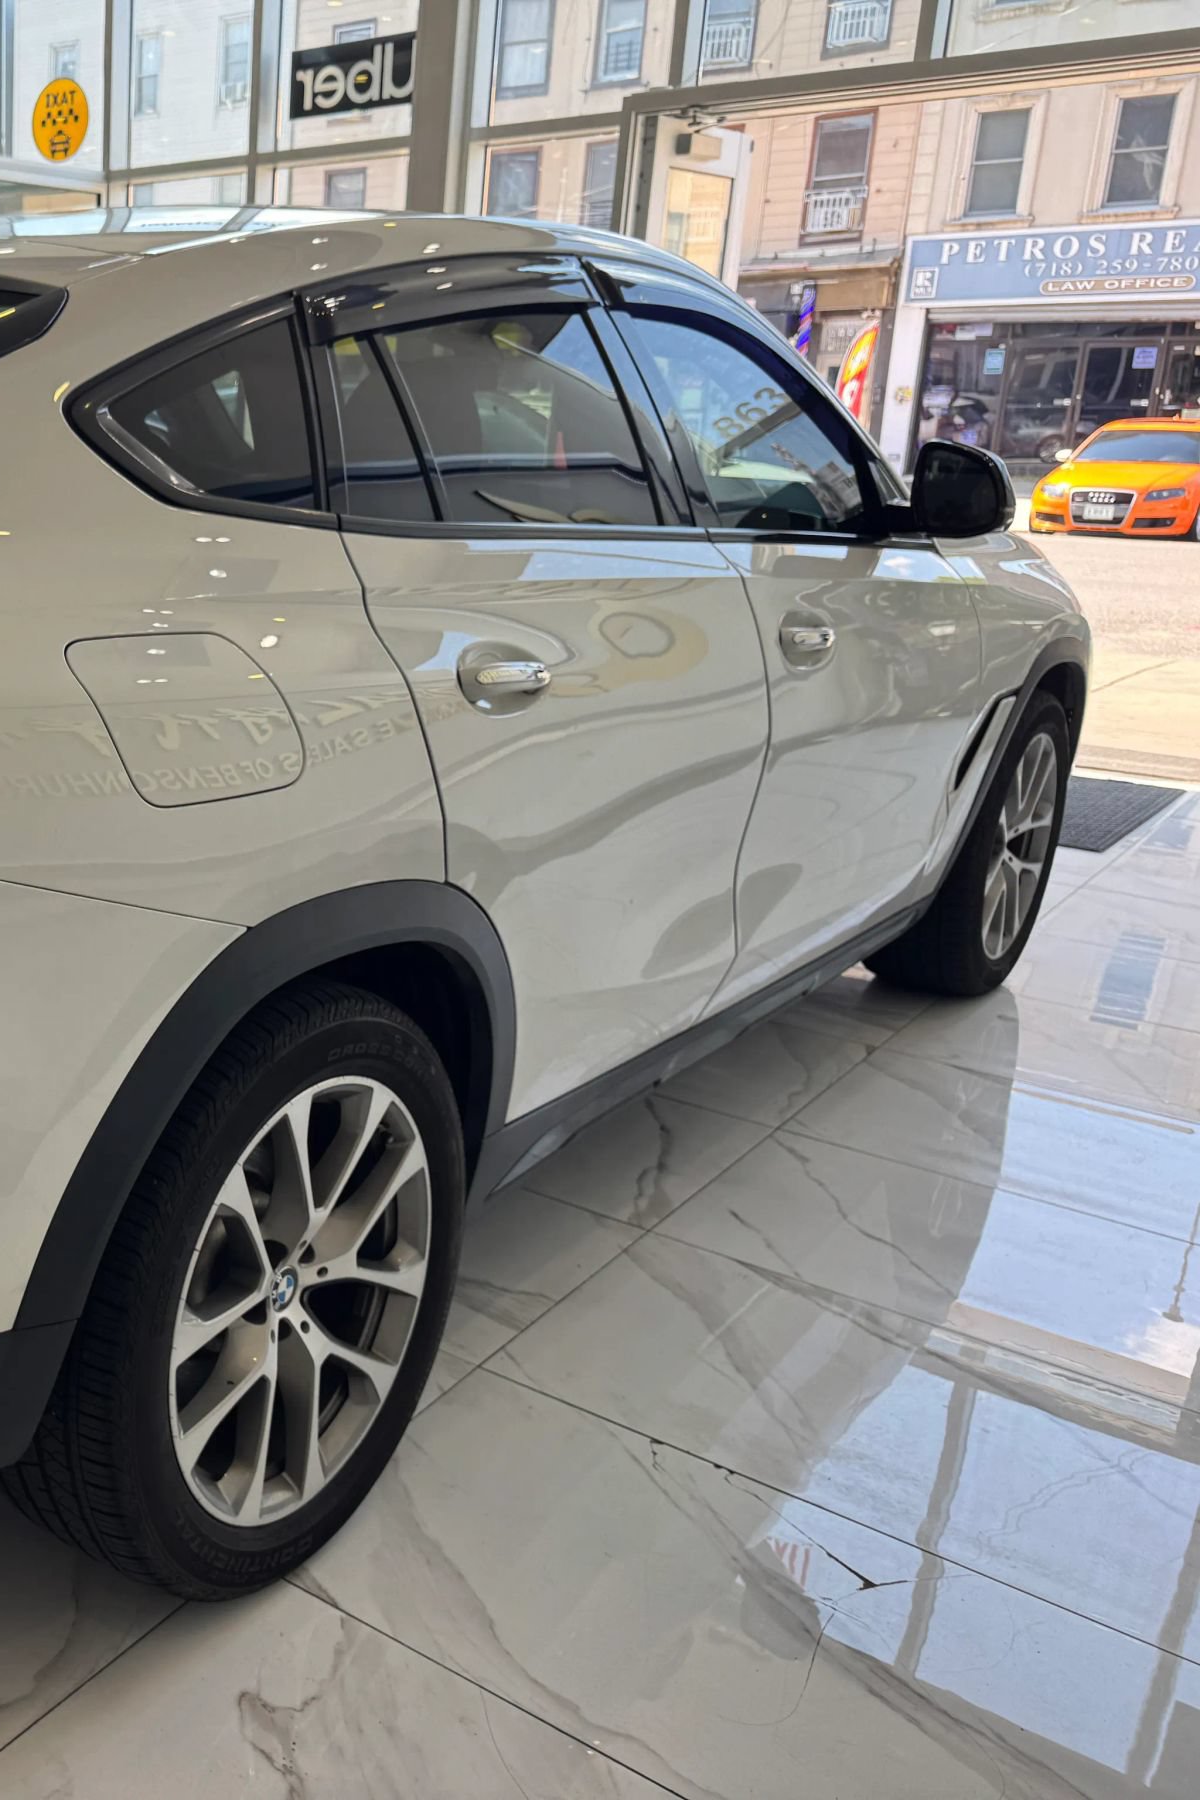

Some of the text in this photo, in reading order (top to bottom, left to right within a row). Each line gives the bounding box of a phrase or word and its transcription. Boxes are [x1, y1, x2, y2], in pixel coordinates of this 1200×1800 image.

[940, 233, 1107, 266] PETROS
[1024, 260, 1083, 278] (718)
[1047, 276, 1189, 293] LAW OFFICE
[713, 387, 788, 438] 863
